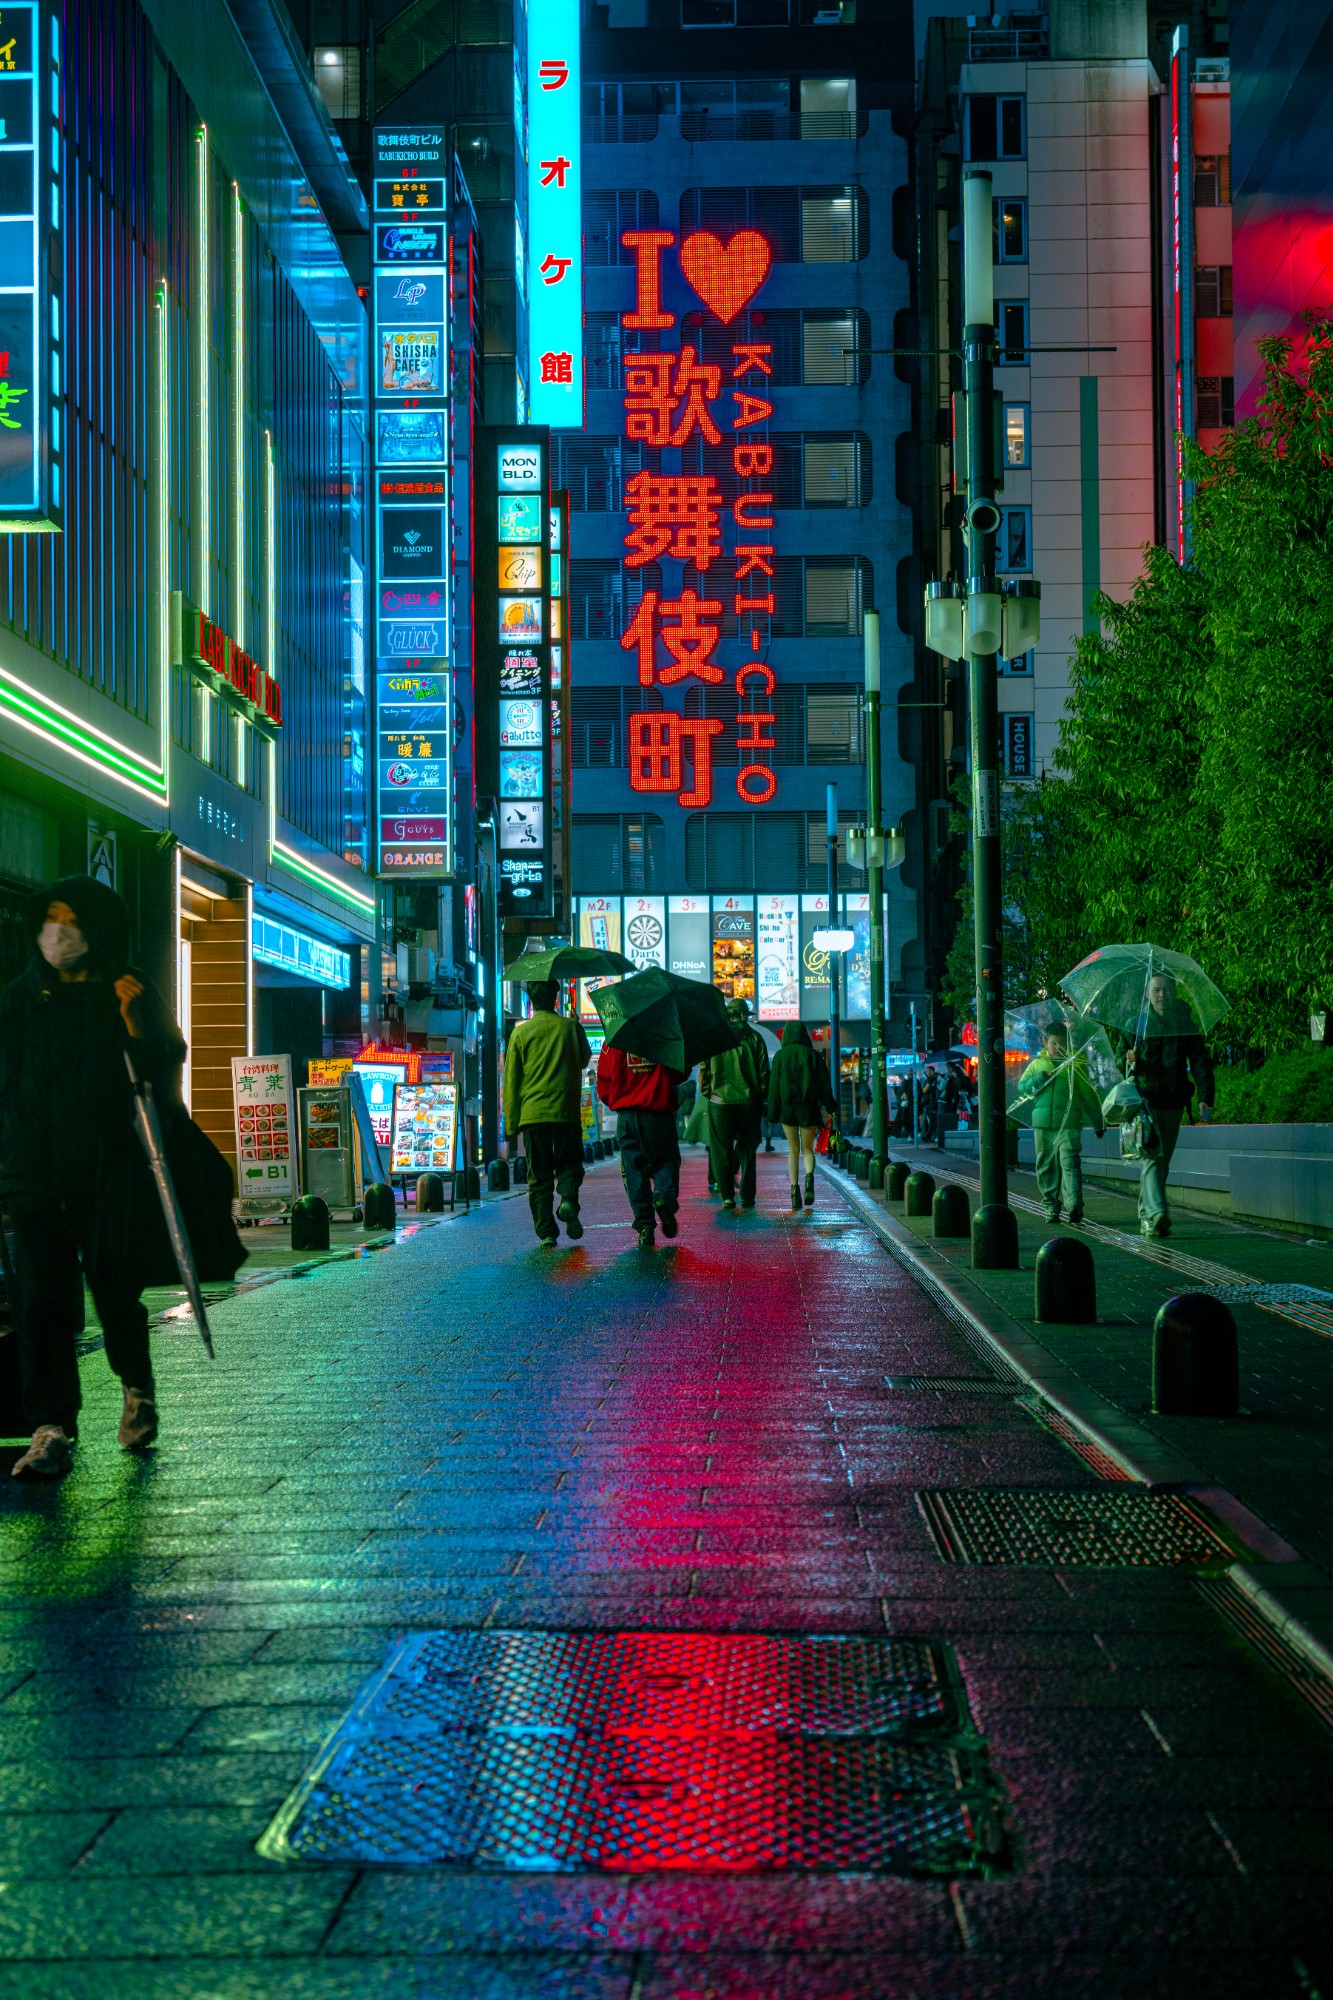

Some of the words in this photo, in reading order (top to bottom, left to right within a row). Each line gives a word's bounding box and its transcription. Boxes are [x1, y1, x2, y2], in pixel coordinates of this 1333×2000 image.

[377, 134, 442, 146] 歌舞伎町ビル
[379, 151, 418, 161] KABUKICHO
[419, 151, 439, 160] BUILD
[401, 168, 418, 178] 6F
[402, 212, 418, 222] 5F
[621, 230, 676, 330] I
[394, 333, 437, 344] 水タバコ
[395, 359, 420, 372] CAFE
[403, 399, 419, 408] 4F
[502, 458, 537, 466] MON
[502, 470, 537, 479] BLD.
[620, 345, 726, 808] 歌舞伎町
[732, 344, 775, 804] KABUKI-CHO
[393, 626, 432, 649] GLÜCK
[199, 610, 262, 708] KABUKICHO
[404, 657, 421, 668] 3F
[503, 656, 538, 668] 個室
[500, 666, 541, 678] ダイニング
[501, 730, 541, 744] Gabutto
[398, 742, 432, 757] 暖簾
[1013, 722, 1025, 773] HOUSE
[383, 853, 444, 865] ORANGE
[587, 898, 611, 911] M2F
[637, 899, 651, 911] 2F
[682, 899, 696, 911] 3F
[725, 897, 739, 910] 4F
[770, 897, 785, 909] 5F
[631, 949, 660, 958] Darts
[242, 1063, 279, 1075] 台湾料理
[311, 1064, 352, 1073] ボードゲーム
[361, 1071, 396, 1082] LAWSON
[237, 1074, 286, 1093] 青葉
[267, 1165, 288, 1179] B1
